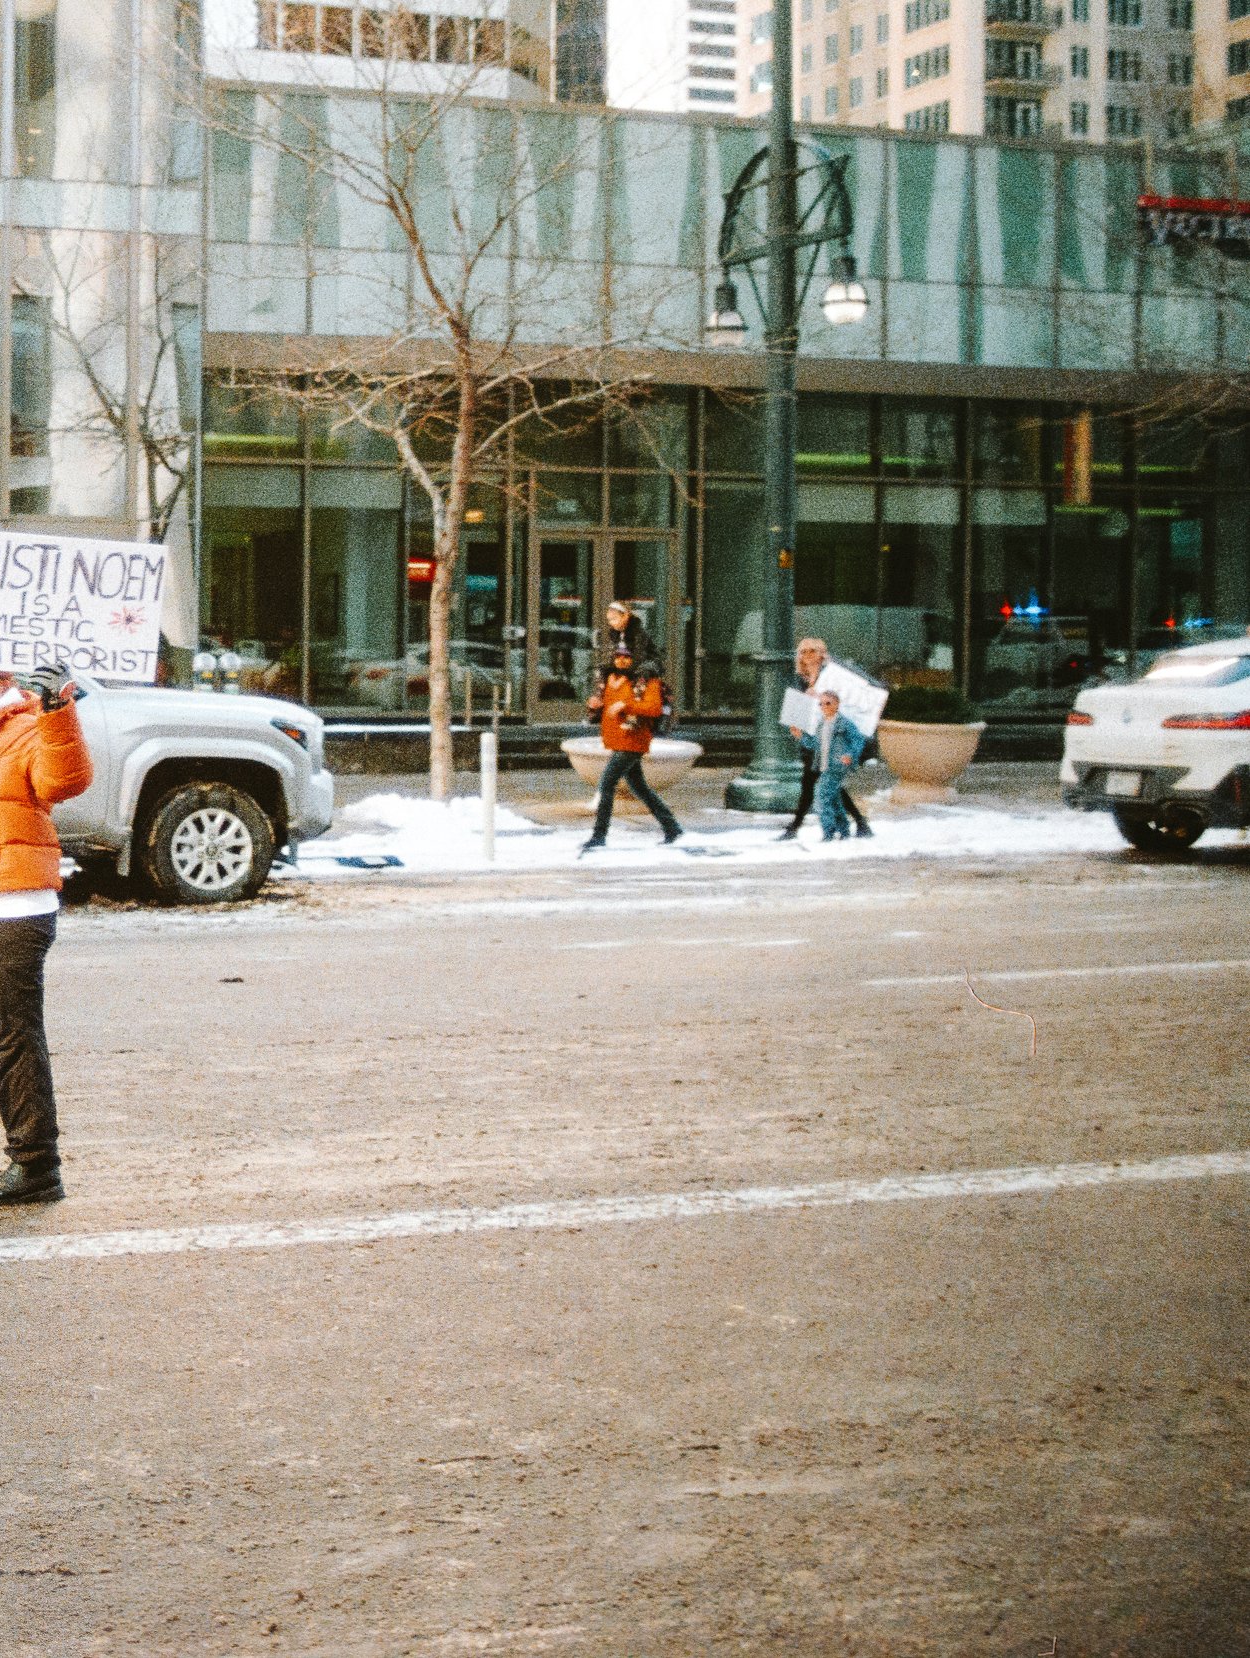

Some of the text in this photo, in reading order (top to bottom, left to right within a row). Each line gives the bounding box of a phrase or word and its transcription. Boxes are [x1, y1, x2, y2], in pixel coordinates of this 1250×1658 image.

[69, 550, 165, 602] NOEM
[21, 590, 83, 619] IS A
